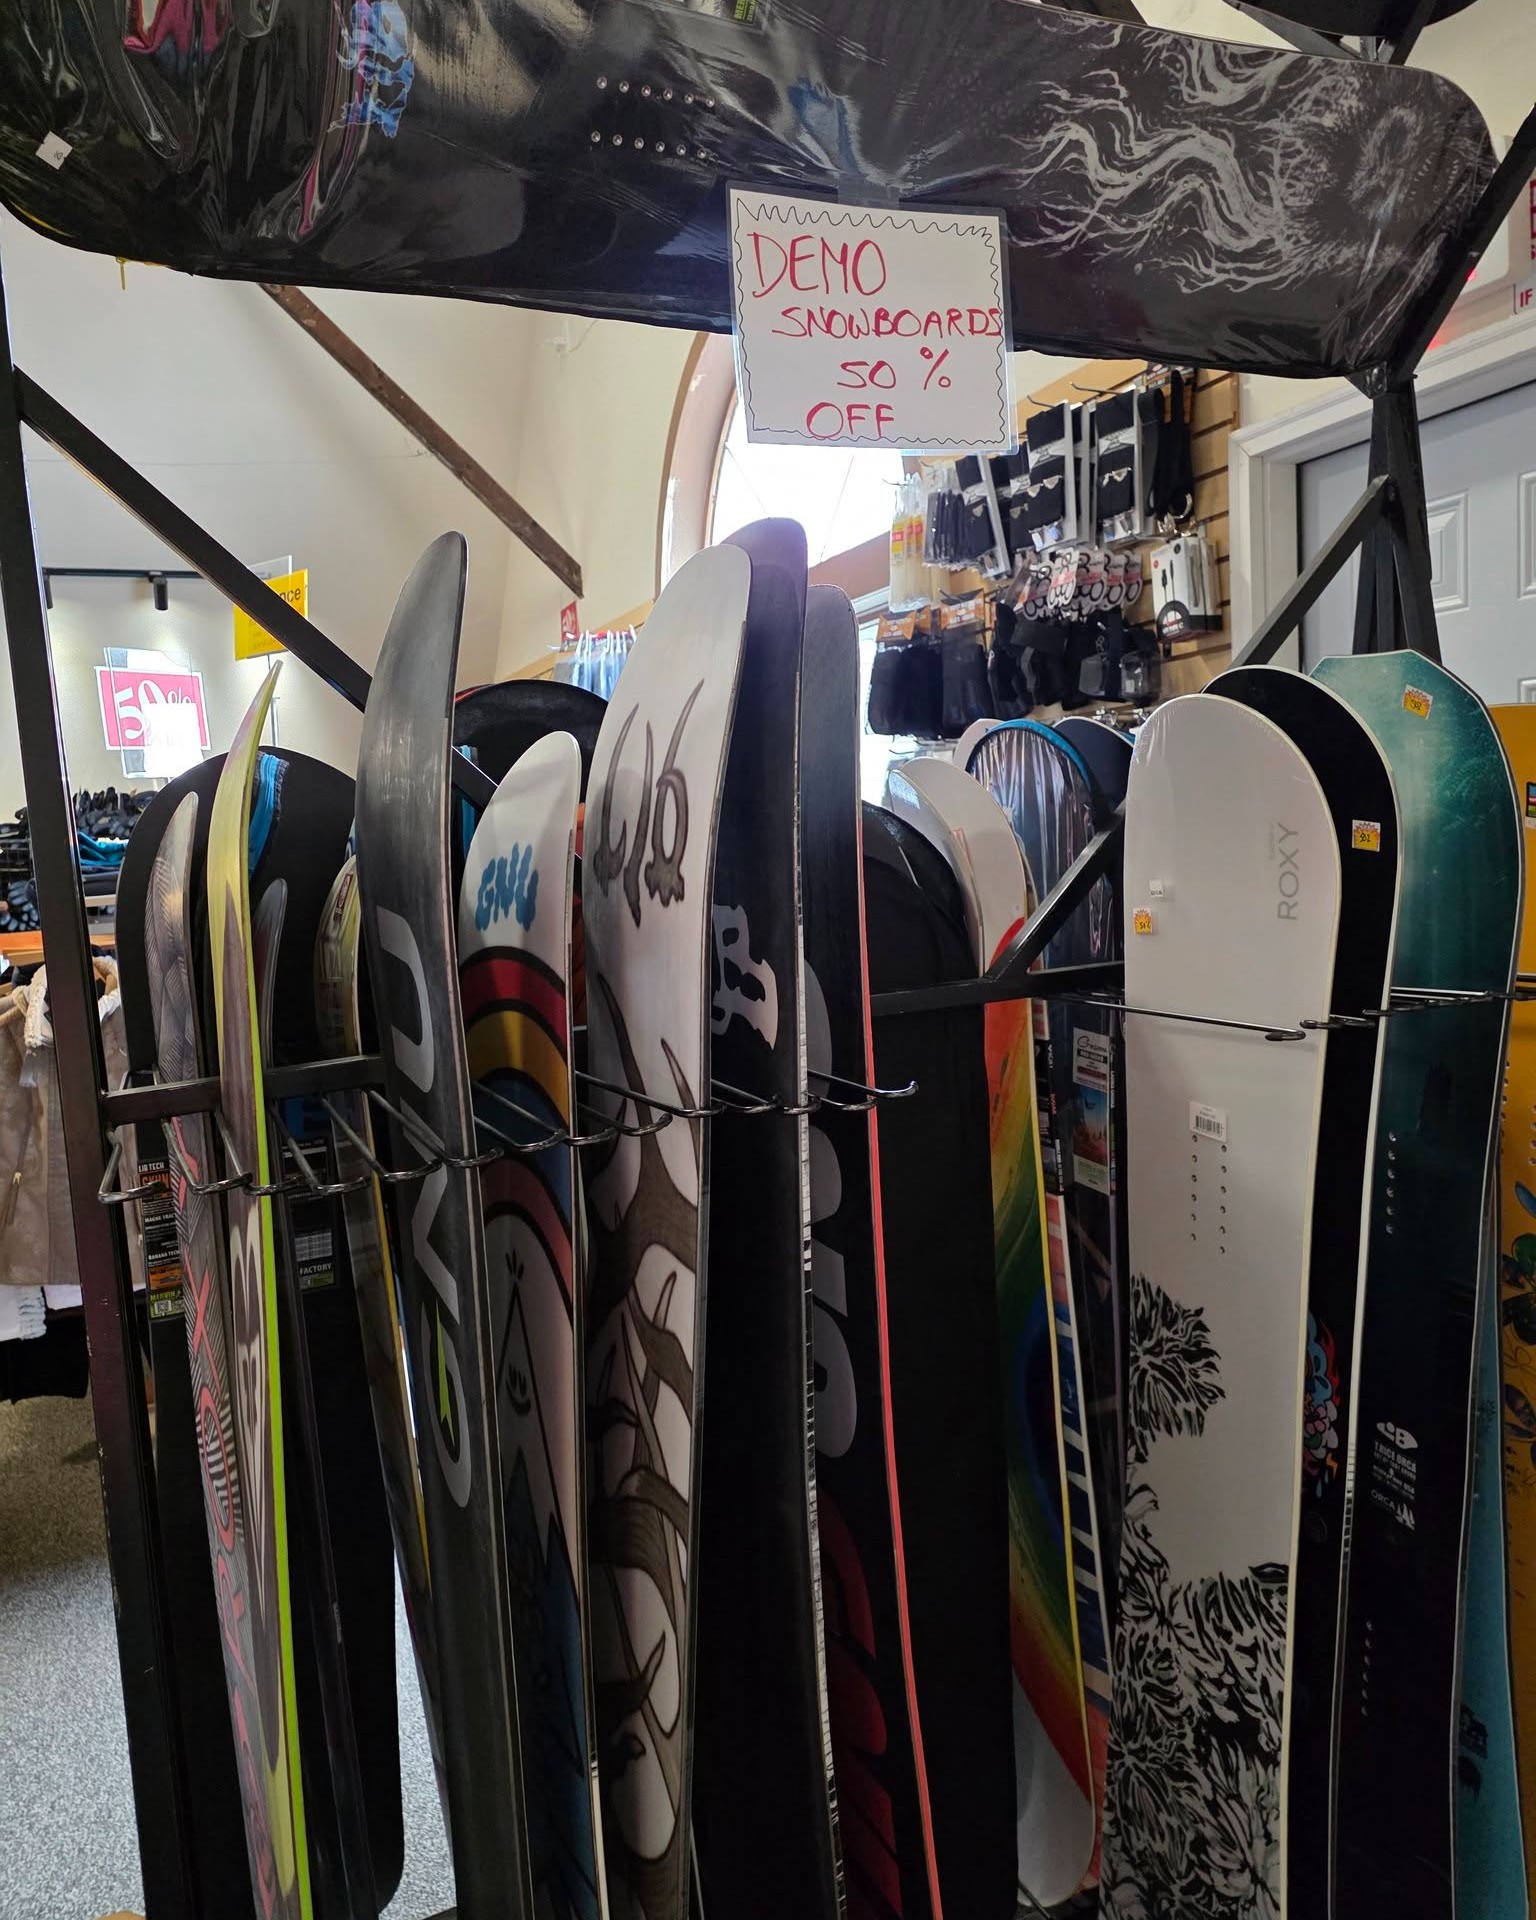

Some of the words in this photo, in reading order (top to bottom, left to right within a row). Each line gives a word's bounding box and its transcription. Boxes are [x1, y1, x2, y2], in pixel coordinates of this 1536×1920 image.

[747, 232, 886, 298] DEMO
[1519, 288, 1534, 308] IF
[772, 306, 1002, 339] SNOWBOARDS
[837, 360, 896, 389] 50
[806, 401, 895, 439] OFF
[475, 842, 539, 932] GNU
[1277, 822, 1299, 920] ROXY
[149, 1161, 165, 1171] TECH
[300, 1262, 332, 1275] FACTORY
